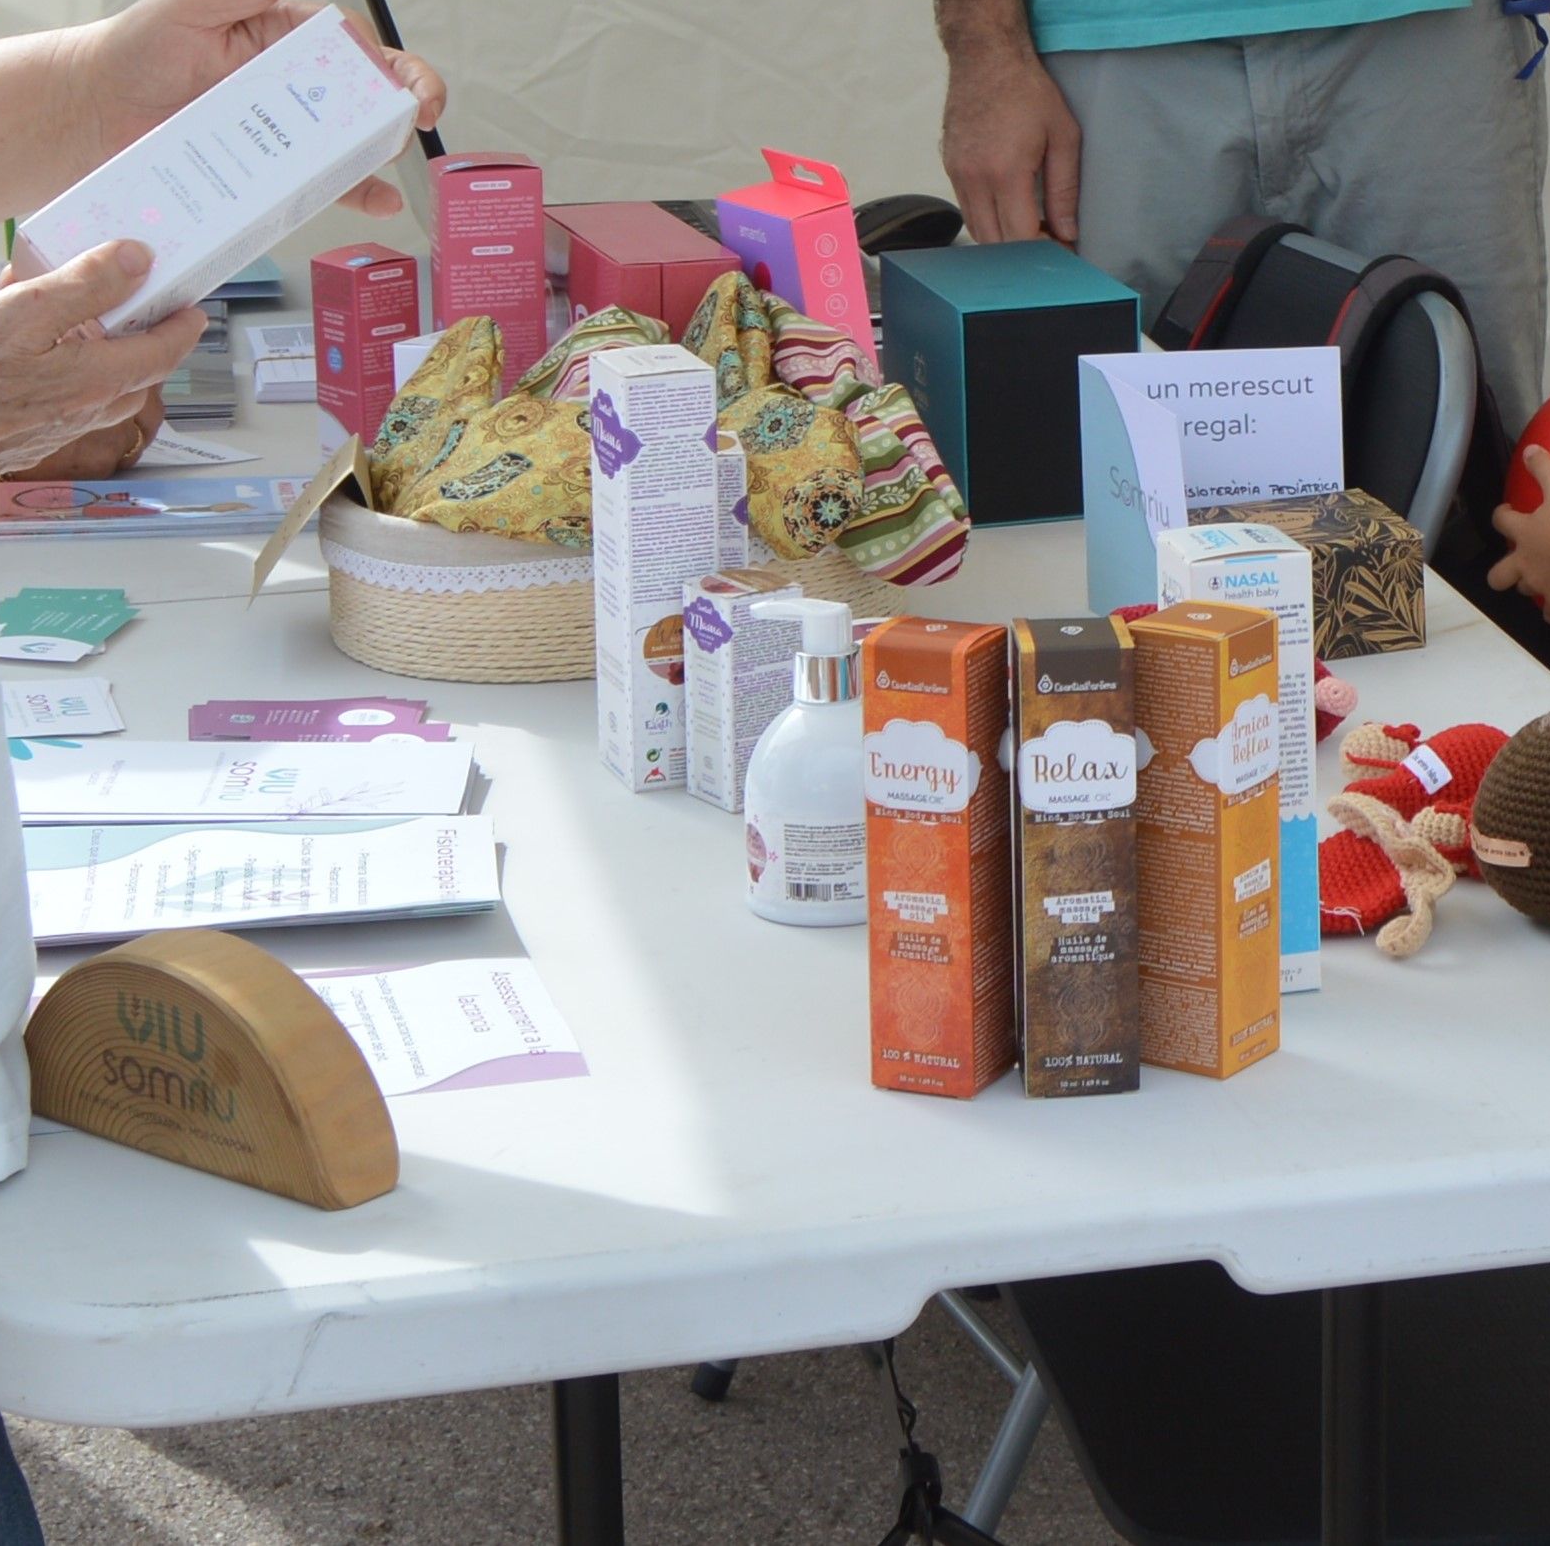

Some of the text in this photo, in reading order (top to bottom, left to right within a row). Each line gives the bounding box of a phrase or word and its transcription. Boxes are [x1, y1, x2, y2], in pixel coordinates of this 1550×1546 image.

[250, 103, 292, 150] LUBRICA
[1146, 375, 1315, 401] un merescut
[1183, 413, 1258, 443] regal:
[1224, 570, 1280, 588] NASAL
[1224, 586, 1280, 600] health baby
[1231, 713, 1271, 743] Arnica
[1232, 739, 1272, 767] Reflex
[868, 751, 963, 794] Energy
[1031, 752, 1129, 784] Relax
[886, 790, 928, 804] MASSAGE
[1048, 793, 1090, 805] MASSAGE
[1106, 808, 1131, 820] Soul
[1057, 934, 1108, 946] Huile de
[881, 1048, 901, 1060] 100
[913, 1053, 961, 1069] NATURAL
[1044, 1053, 1124, 1068] 100% NATURAL
